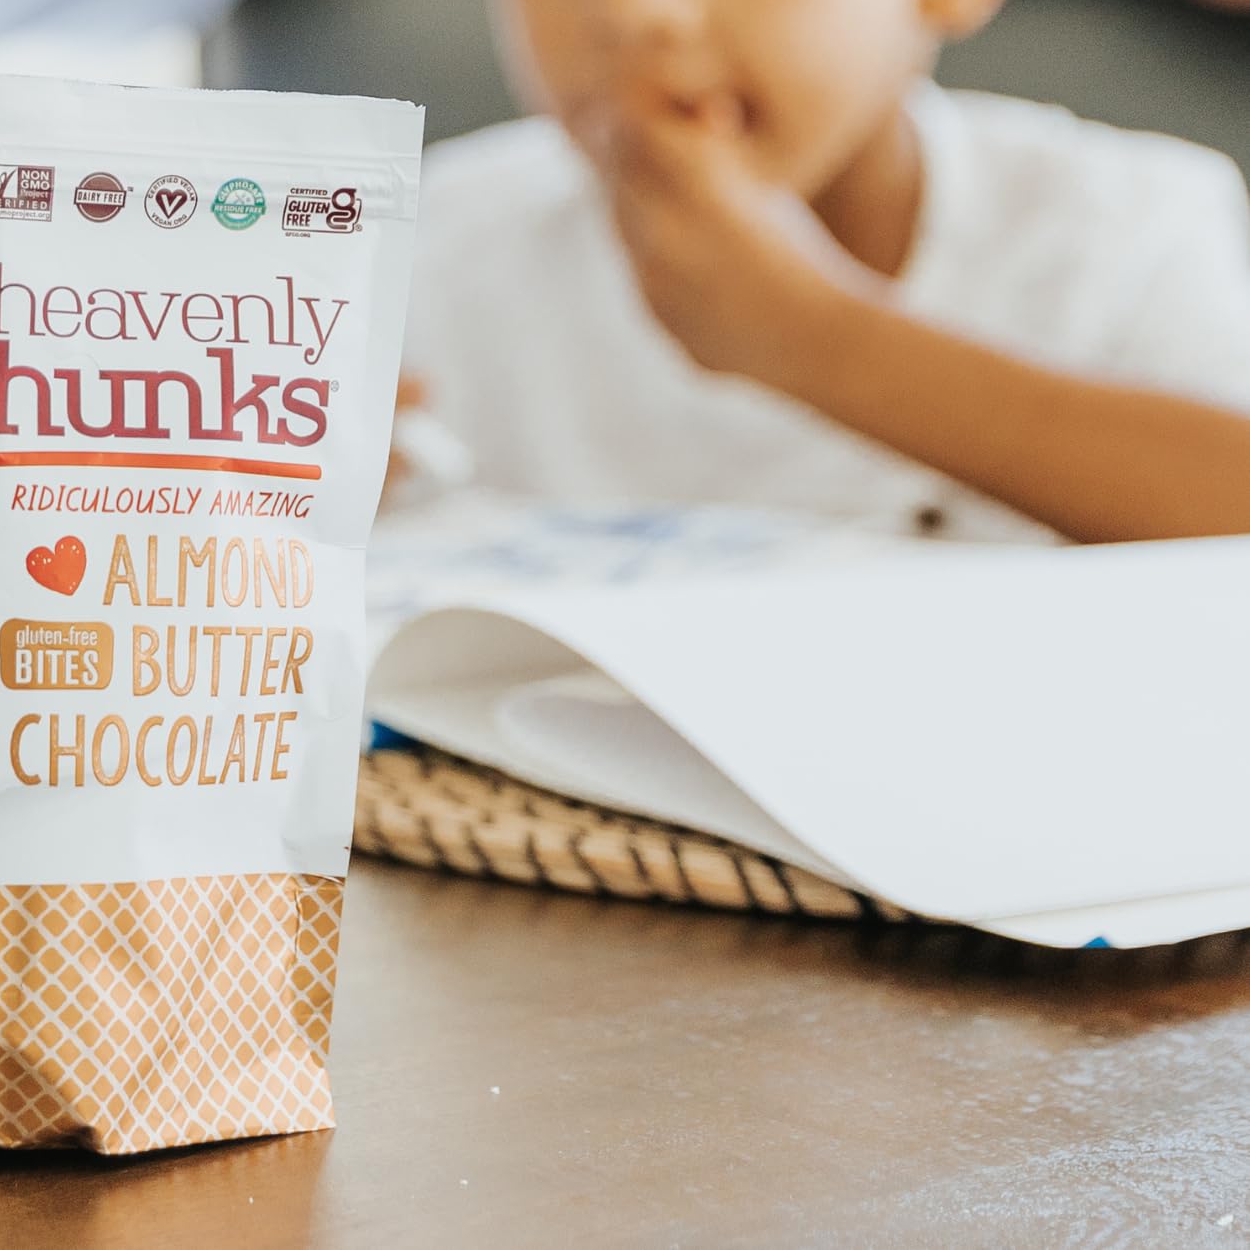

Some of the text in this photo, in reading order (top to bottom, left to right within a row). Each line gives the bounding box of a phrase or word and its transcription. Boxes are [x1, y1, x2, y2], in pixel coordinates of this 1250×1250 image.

[21, 169, 50, 181] NON
[20, 179, 50, 191] GMO
[20, 189, 49, 199] Project
[148, 177, 196, 202] CERTIFIED VEGAN
[290, 187, 328, 196] CERTIFIED
[77, 191, 123, 204] DAIRY FREE
[288, 200, 330, 214] GLUTEN
[286, 213, 311, 227] FREE
[11, 484, 314, 519] RIDICULOUSLY AMAZING
[102, 534, 315, 608] ALMOND
[15, 625, 98, 648] gluten-free
[15, 649, 99, 686] BITES
[132, 624, 314, 697] BUTTER
[10, 710, 298, 787] CHOCOLATE
